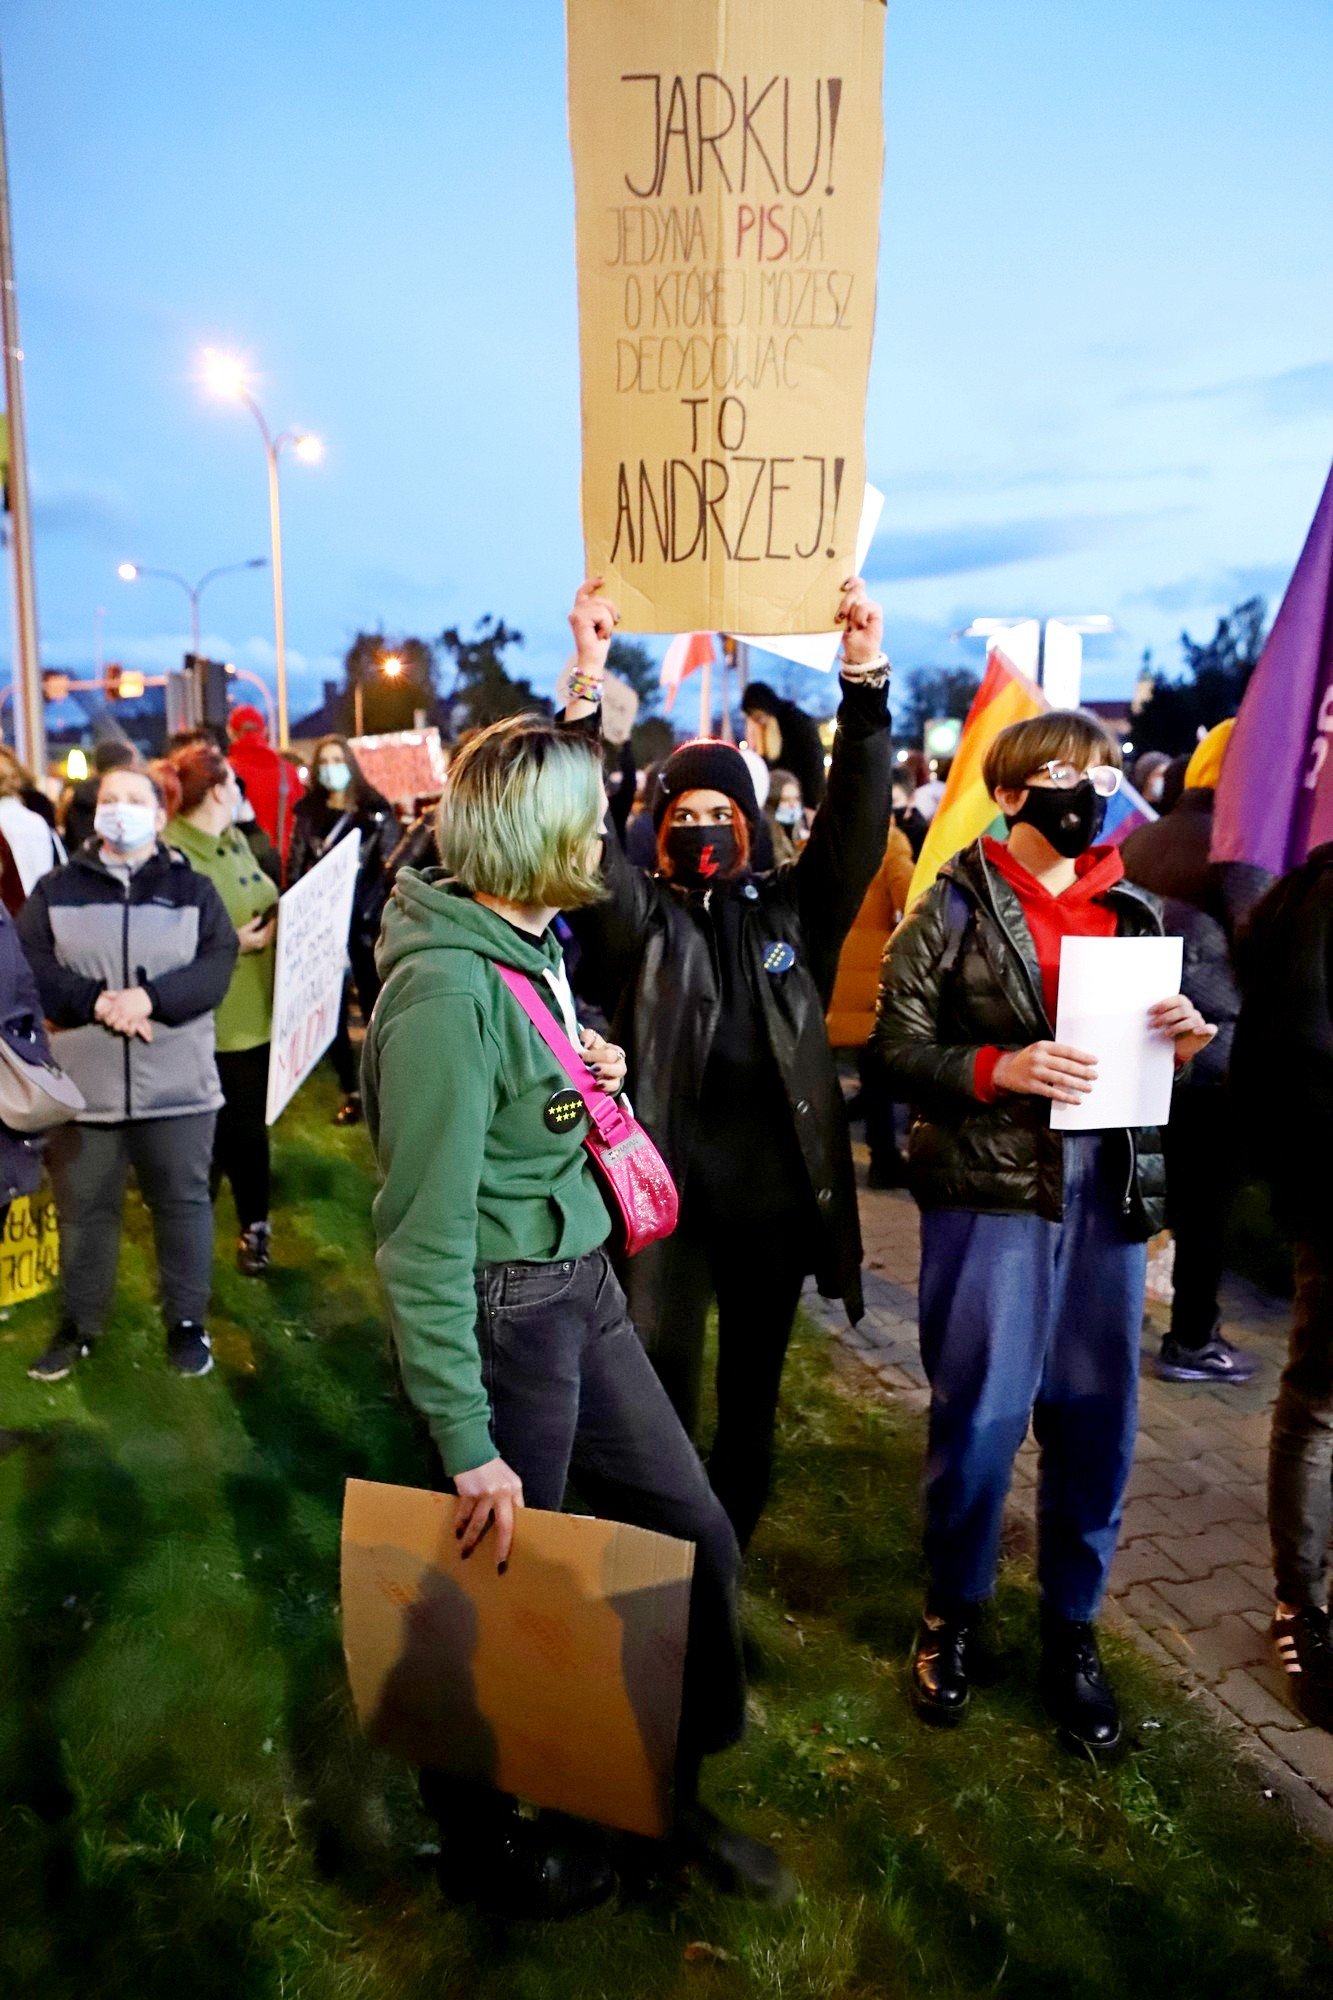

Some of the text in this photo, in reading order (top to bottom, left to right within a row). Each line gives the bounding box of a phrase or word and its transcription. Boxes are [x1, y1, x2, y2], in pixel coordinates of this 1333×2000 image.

[620, 72, 842, 198] JARKU!
[604, 203, 825, 267] JEDYNA PISDA
[624, 273, 641, 330] O
[652, 266, 747, 330] KTÓREJ
[681, 396, 746, 452] TO
[610, 455, 845, 563] ANDRZEJ!
